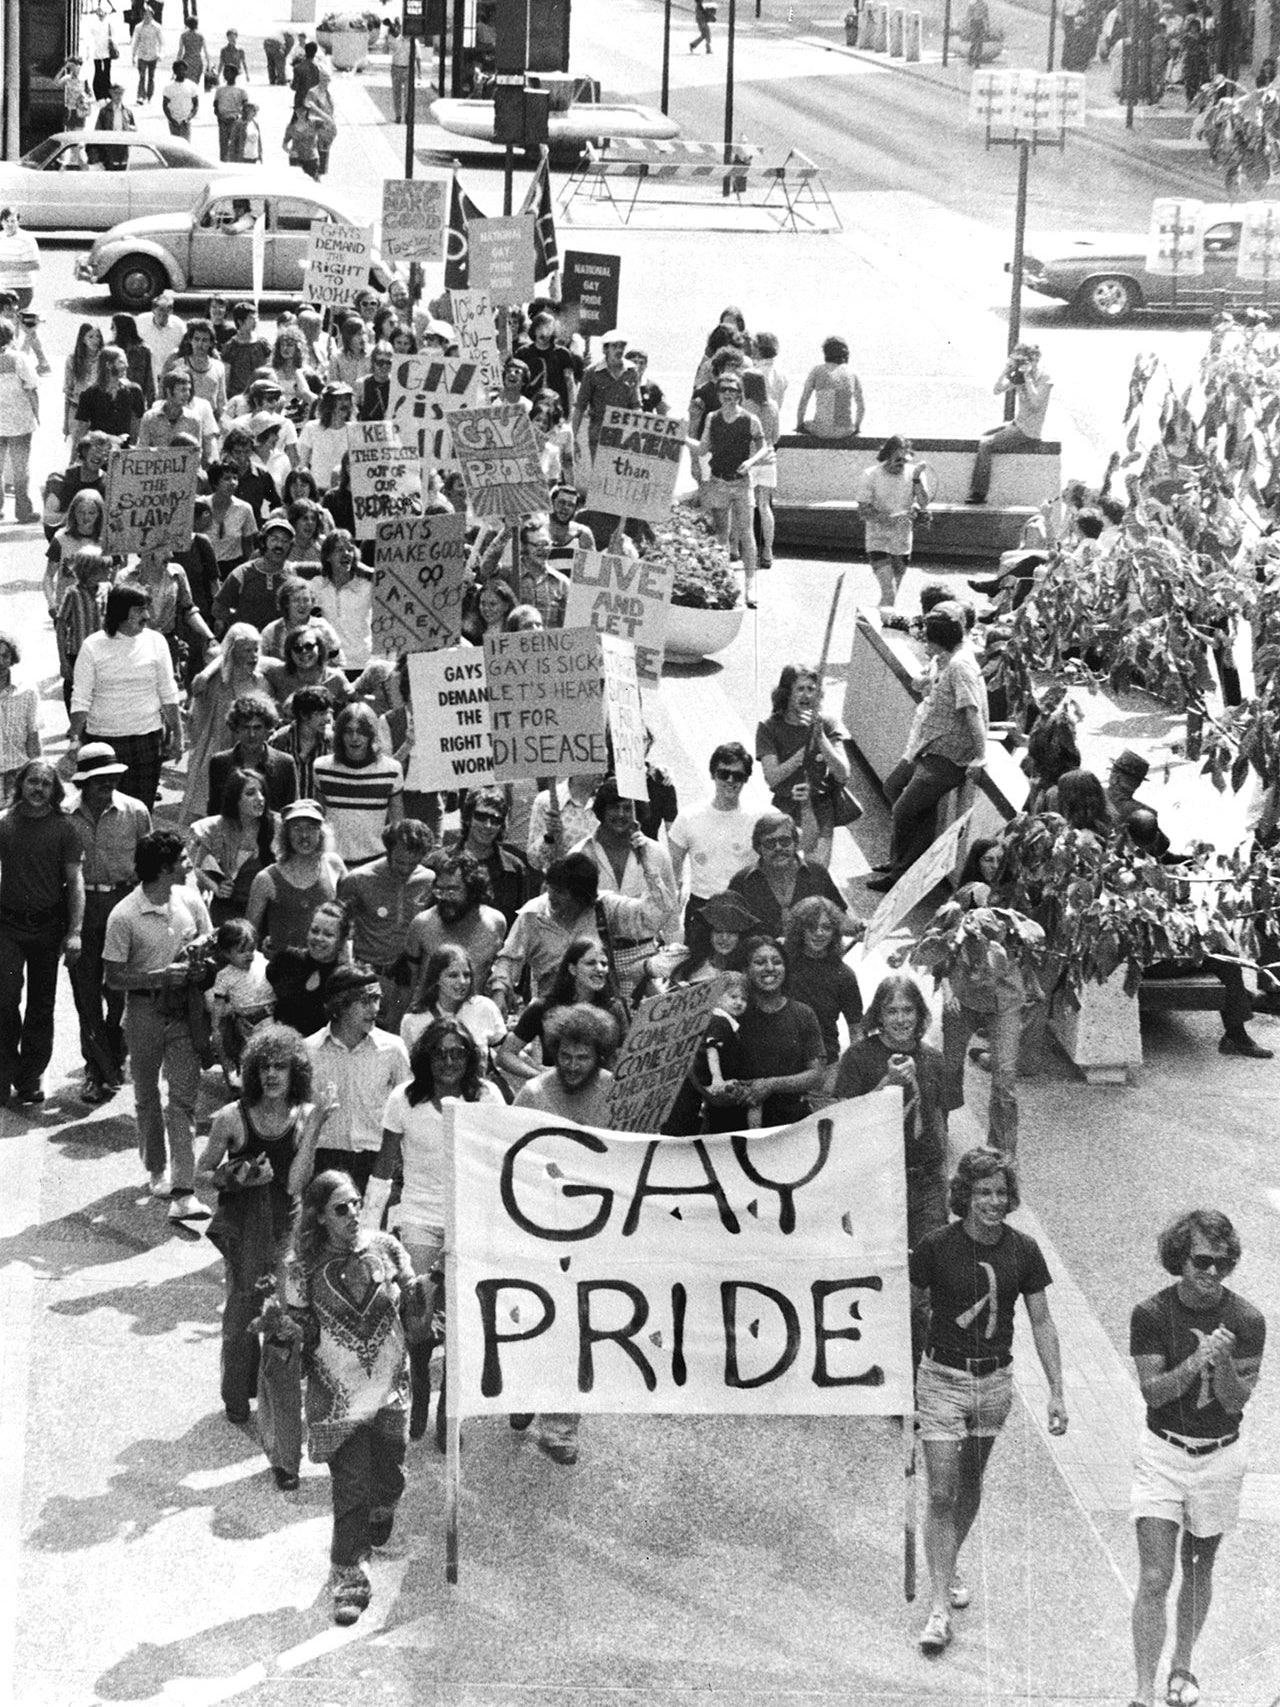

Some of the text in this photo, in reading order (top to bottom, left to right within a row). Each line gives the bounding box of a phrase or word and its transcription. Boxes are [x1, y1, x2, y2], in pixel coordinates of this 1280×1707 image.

[321, 223, 361, 240] GAYS
[315, 237, 365, 254] DEMAND
[326, 252, 344, 262] THE
[325, 274, 344, 286] TO
[574, 263, 611, 277] NATIONAL
[583, 280, 600, 292] GAY
[397, 360, 477, 395] GAY
[457, 416, 521, 450] GAY
[610, 410, 680, 436] BETTER
[352, 448, 379, 462] THE
[366, 464, 406, 479] OUT OF
[466, 458, 543, 489] PRIDE
[613, 456, 650, 479] than
[141, 479, 168, 491] THE
[375, 479, 398, 492] OUR
[130, 506, 177, 527] LAW
[379, 520, 431, 541] GAYS
[377, 541, 465, 562] MAKE GOOD
[573, 550, 667, 601] LIVE
[592, 591, 644, 617] AND
[590, 612, 643, 638] LET
[491, 633, 574, 655] IF BEING
[444, 663, 482, 682] GAYS
[489, 654, 598, 676] GAY IS SICK
[438, 687, 490, 706] DEMAN
[490, 681, 601, 701] LET'S HEAR
[456, 709, 483, 726] THE
[494, 708, 559, 730] IT FOR
[440, 734, 482, 753] RIGHT
[493, 734, 606, 765] DISEASE
[452, 756, 494, 775] WORK
[615, 1032, 703, 1081] COME OUT
[500, 1118, 834, 1242] GAY
[475, 1274, 886, 1399] PRIDE
